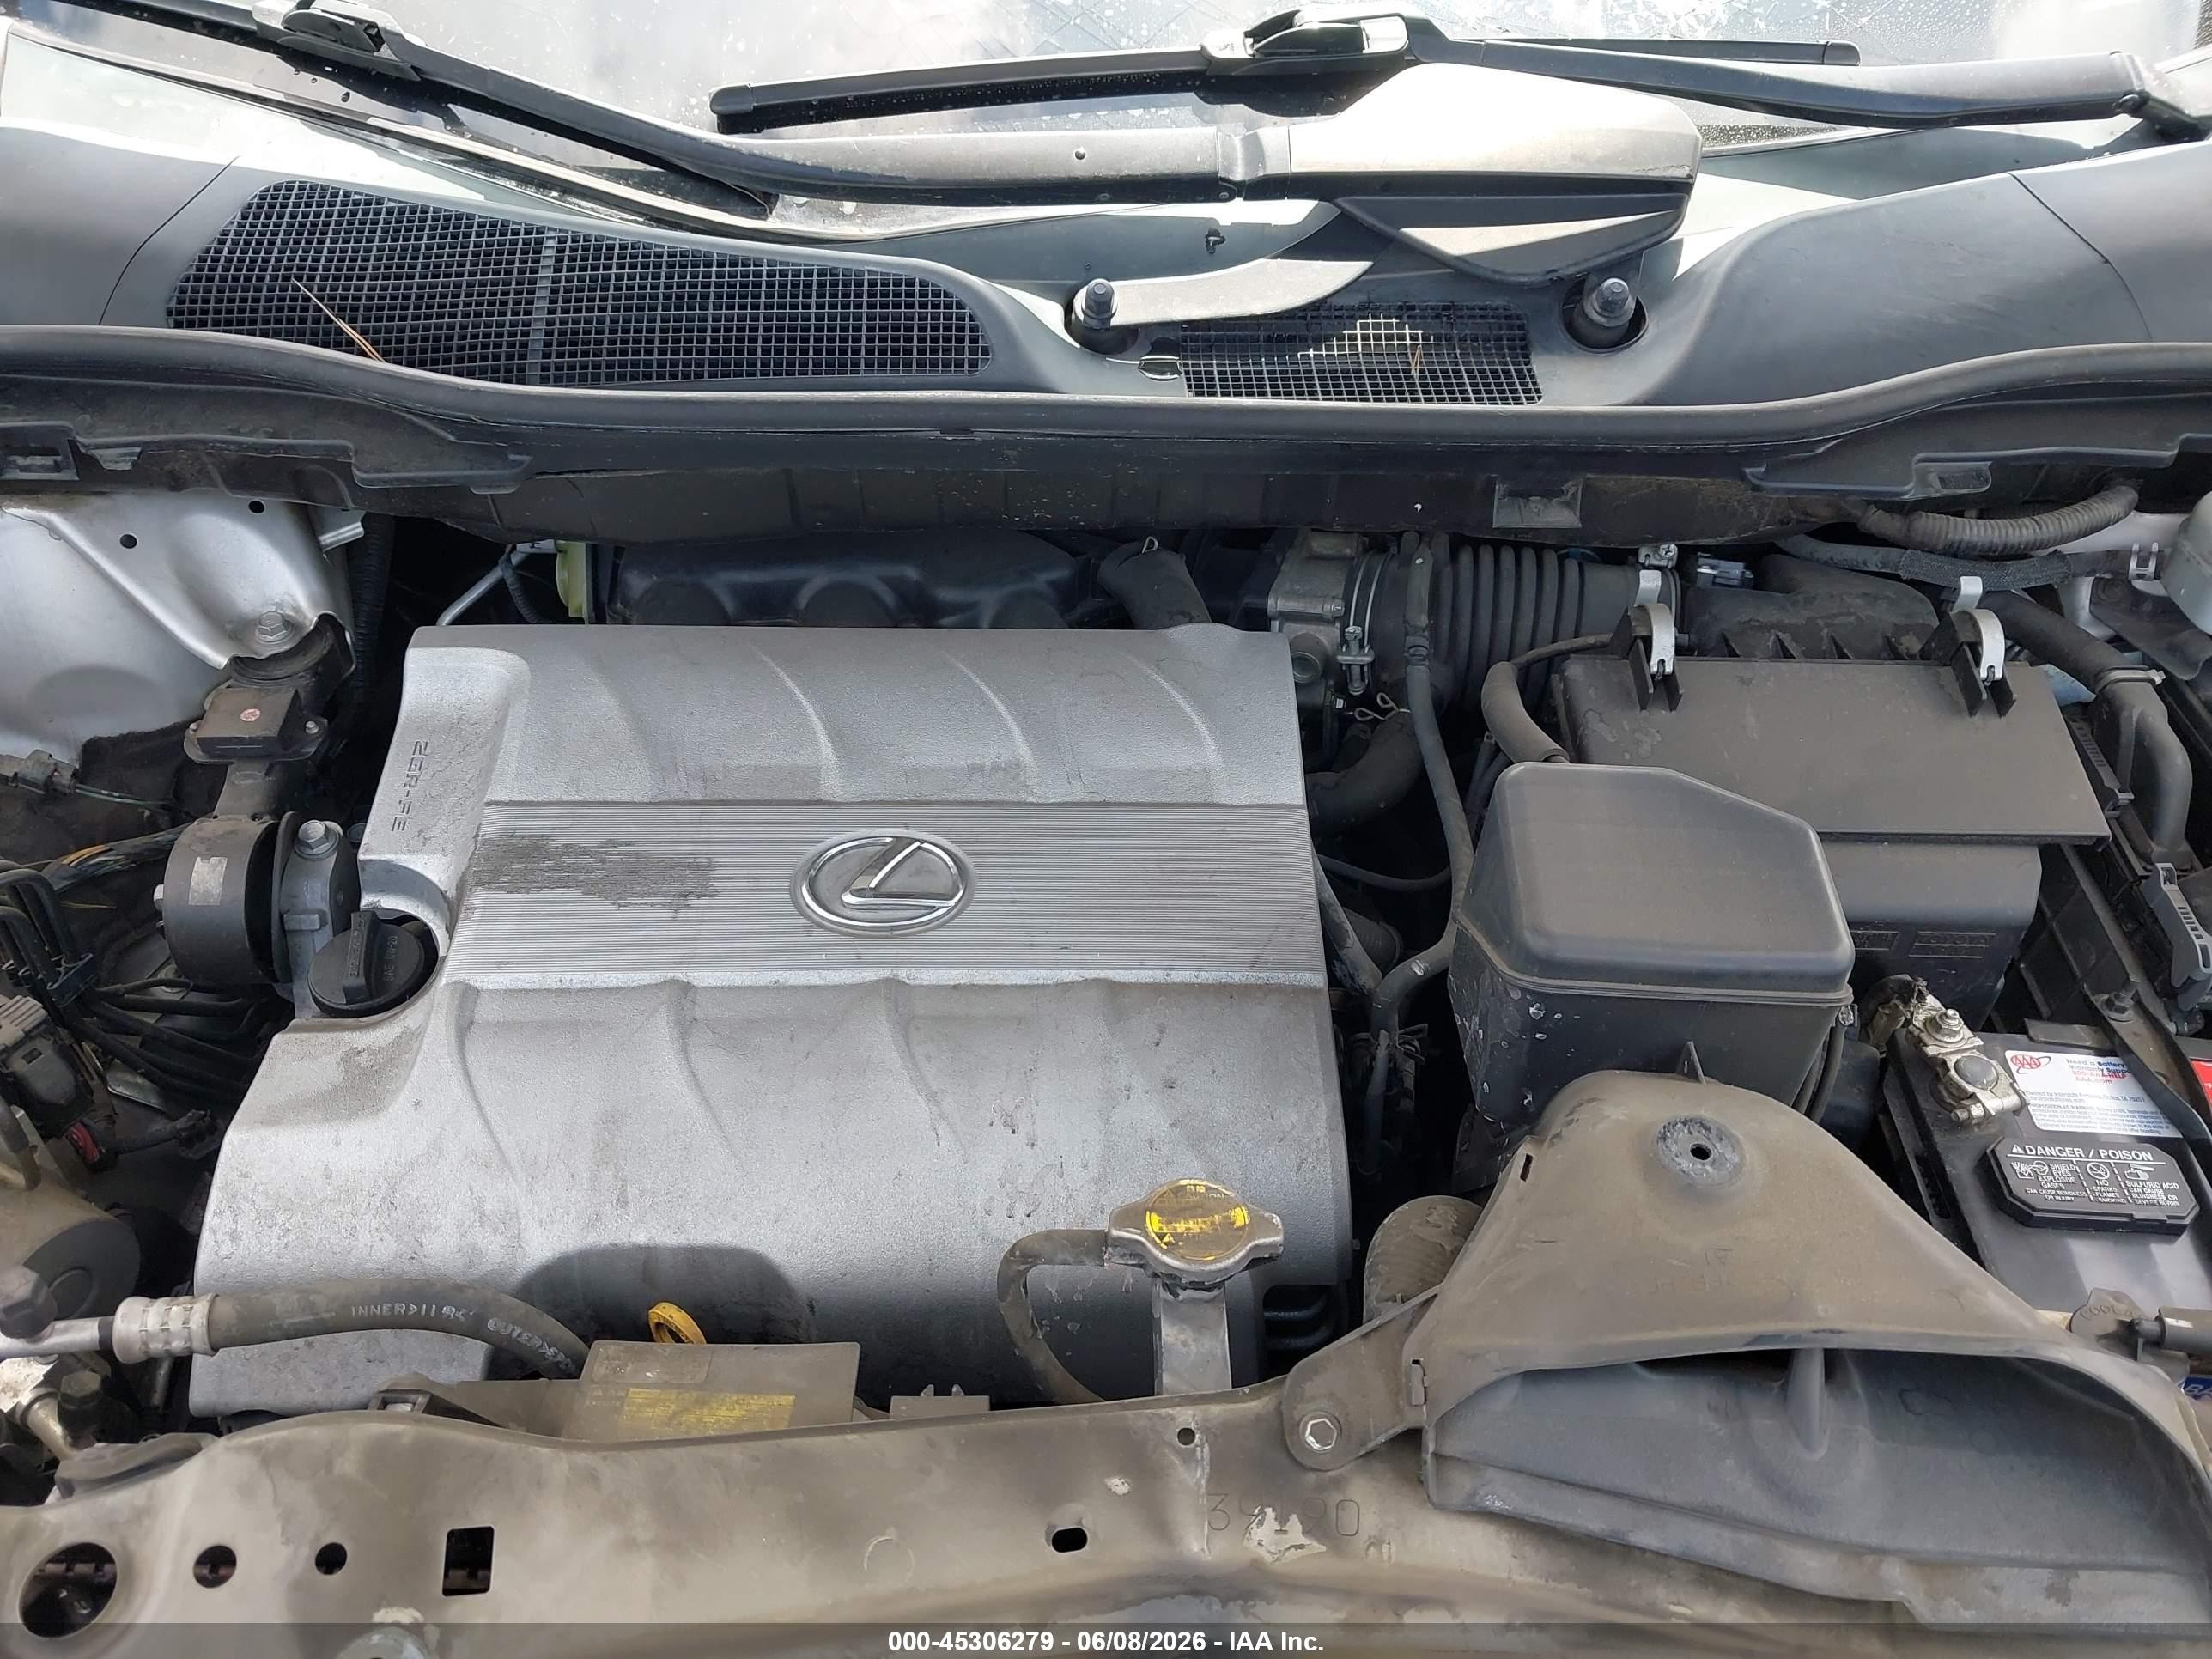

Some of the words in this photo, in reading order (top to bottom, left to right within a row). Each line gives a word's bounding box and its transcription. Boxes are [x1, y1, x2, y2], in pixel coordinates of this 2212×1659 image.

[392, 740, 428, 832] 2GR-FE
[2014, 1056, 2039, 1069] AAA
[2025, 1145, 2085, 1158] DANGER
[2088, 1148, 2094, 1158] /
[2100, 1149, 2154, 1161] POISON
[2125, 1180, 2160, 1188] SULFURIC
